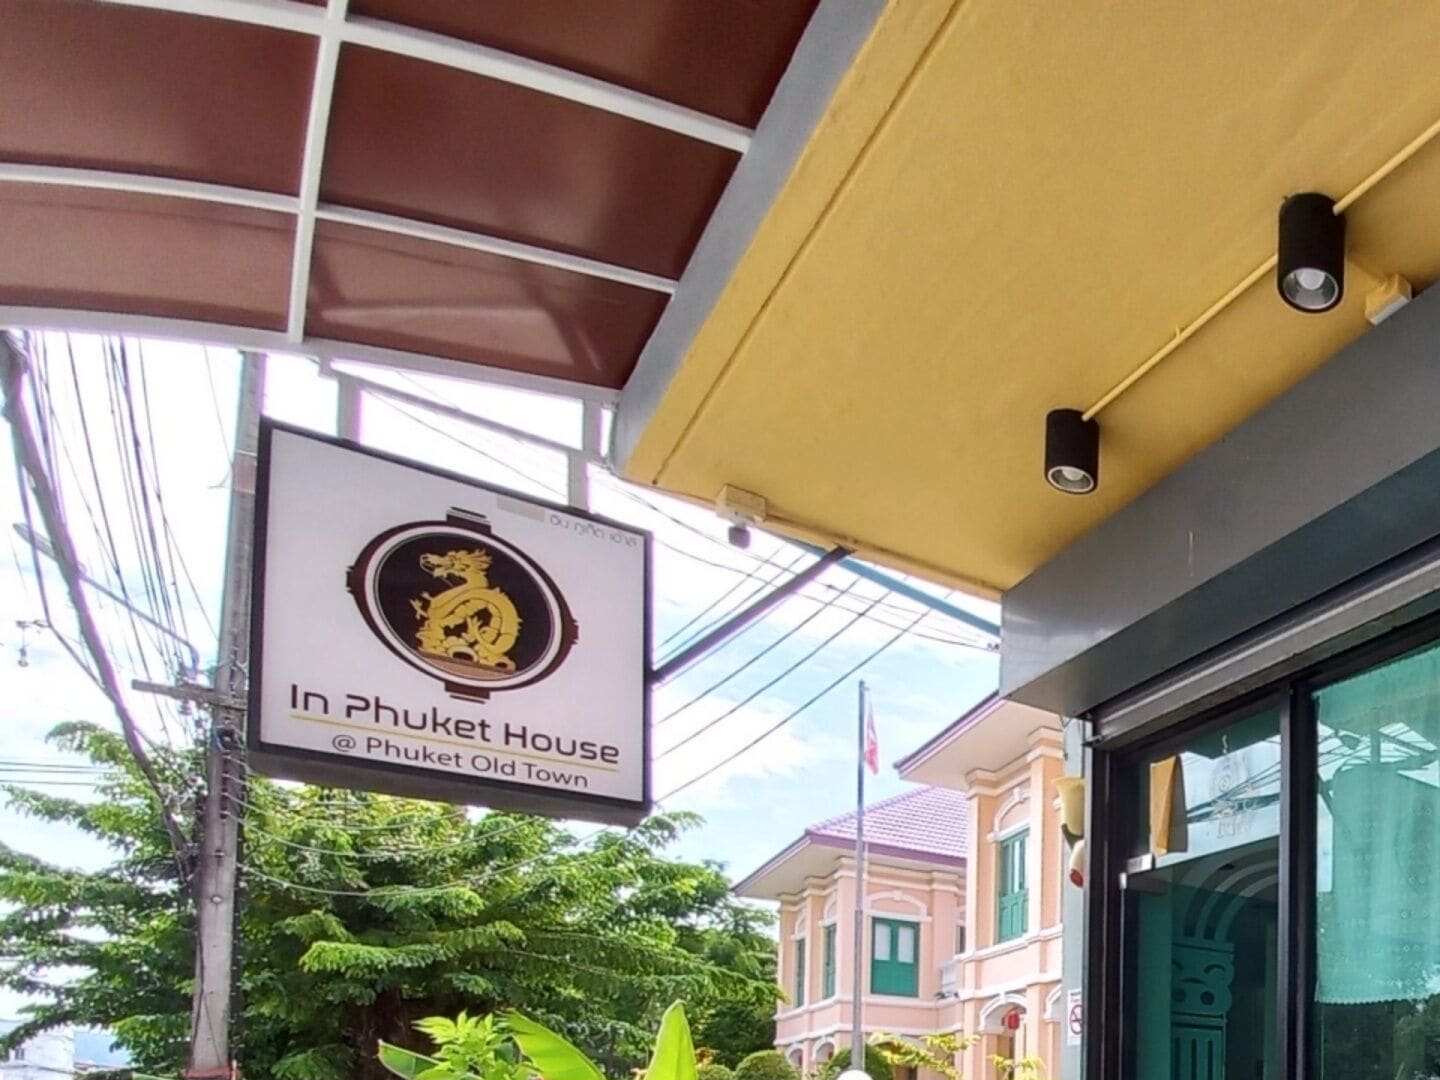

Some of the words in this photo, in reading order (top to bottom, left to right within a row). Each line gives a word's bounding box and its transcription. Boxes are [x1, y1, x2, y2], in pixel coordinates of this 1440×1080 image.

[290, 684, 329, 715] In
[346, 694, 491, 743] Phuket
[505, 722, 620, 765] House
[332, 735, 356, 752] @
[366, 737, 462, 769] Phuket
[471, 754, 516, 777] Old
[522, 763, 588, 788] Town
